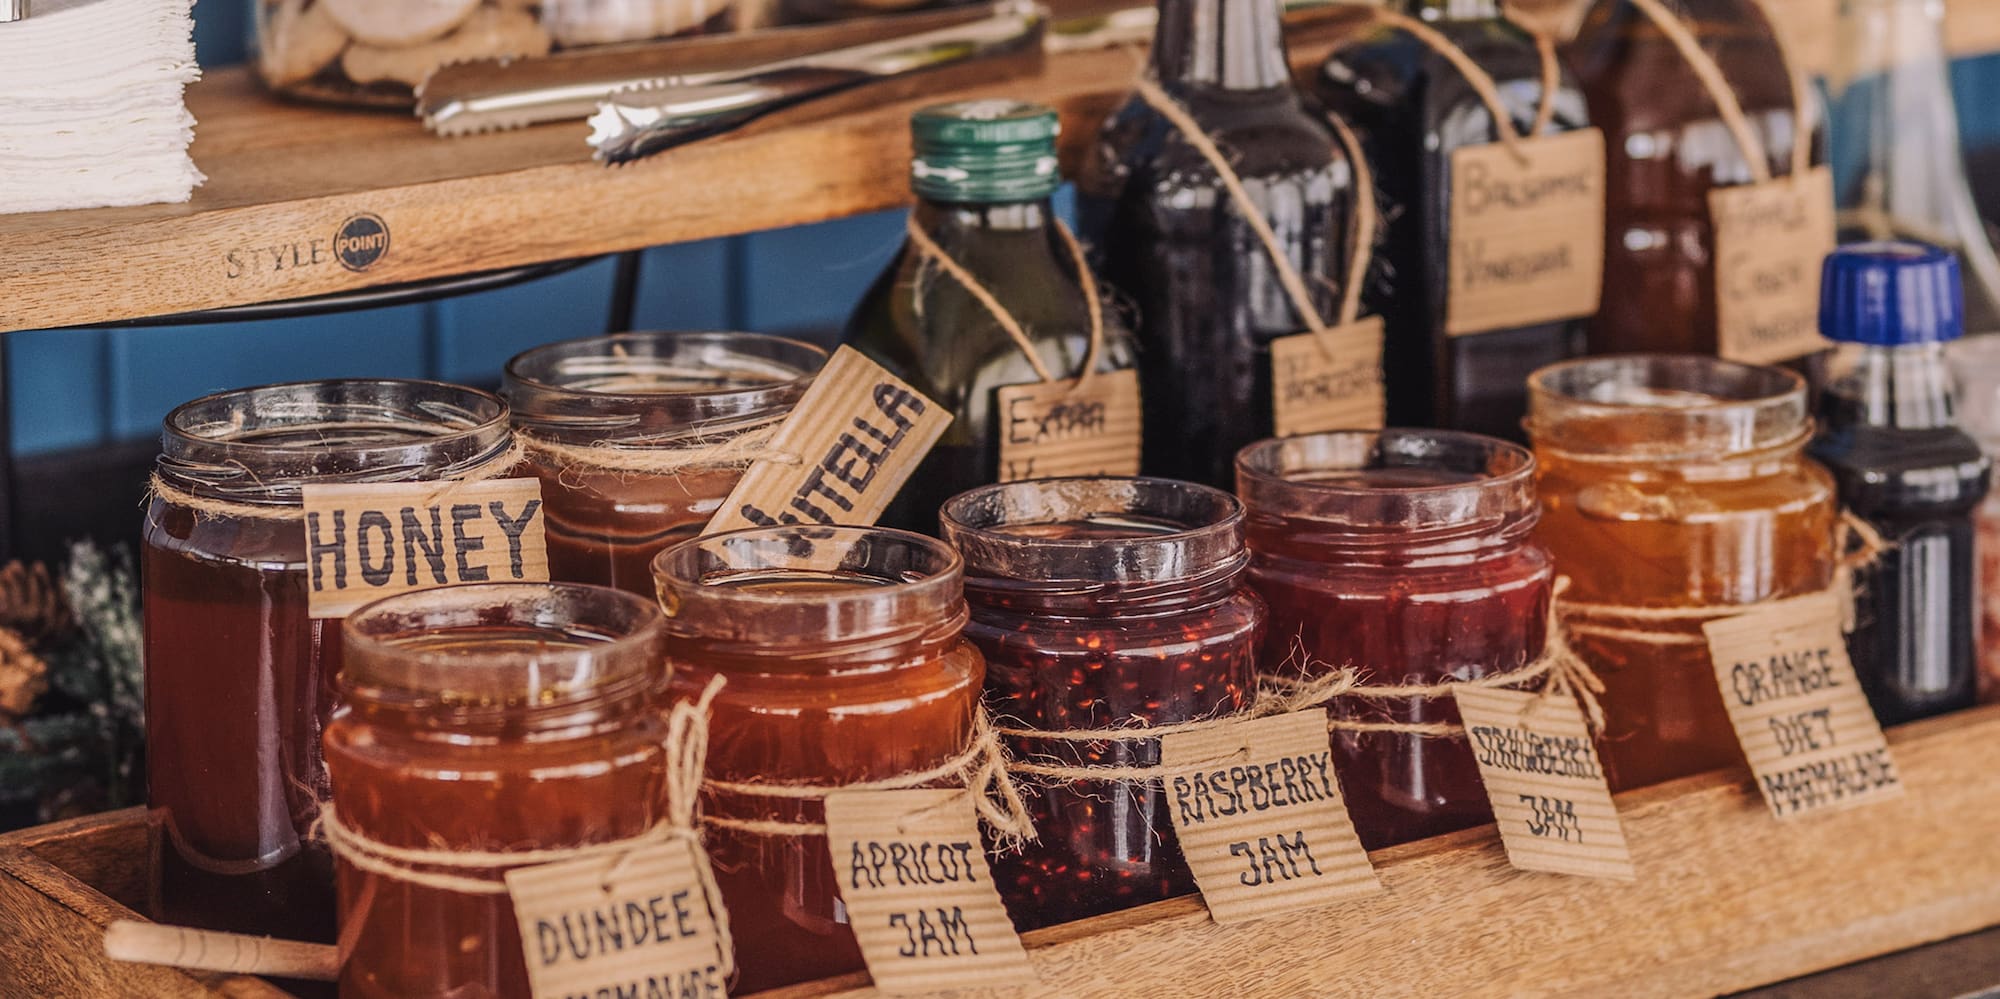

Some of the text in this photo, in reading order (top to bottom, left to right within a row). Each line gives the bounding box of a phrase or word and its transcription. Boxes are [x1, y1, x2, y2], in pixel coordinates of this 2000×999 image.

[225, 232, 385, 279] STYLE POINT
[307, 499, 542, 592] HONEY
[1732, 649, 1842, 706] ORANGE
[1768, 709, 1837, 757] DIET
[1173, 751, 1334, 826] RASPBERRY
[1519, 794, 1584, 844] JAM
[851, 840, 977, 889] APRICOT
[1229, 830, 1323, 887] JAM
[536, 889, 697, 966] DUNDEE
[888, 905, 979, 957] JAM
